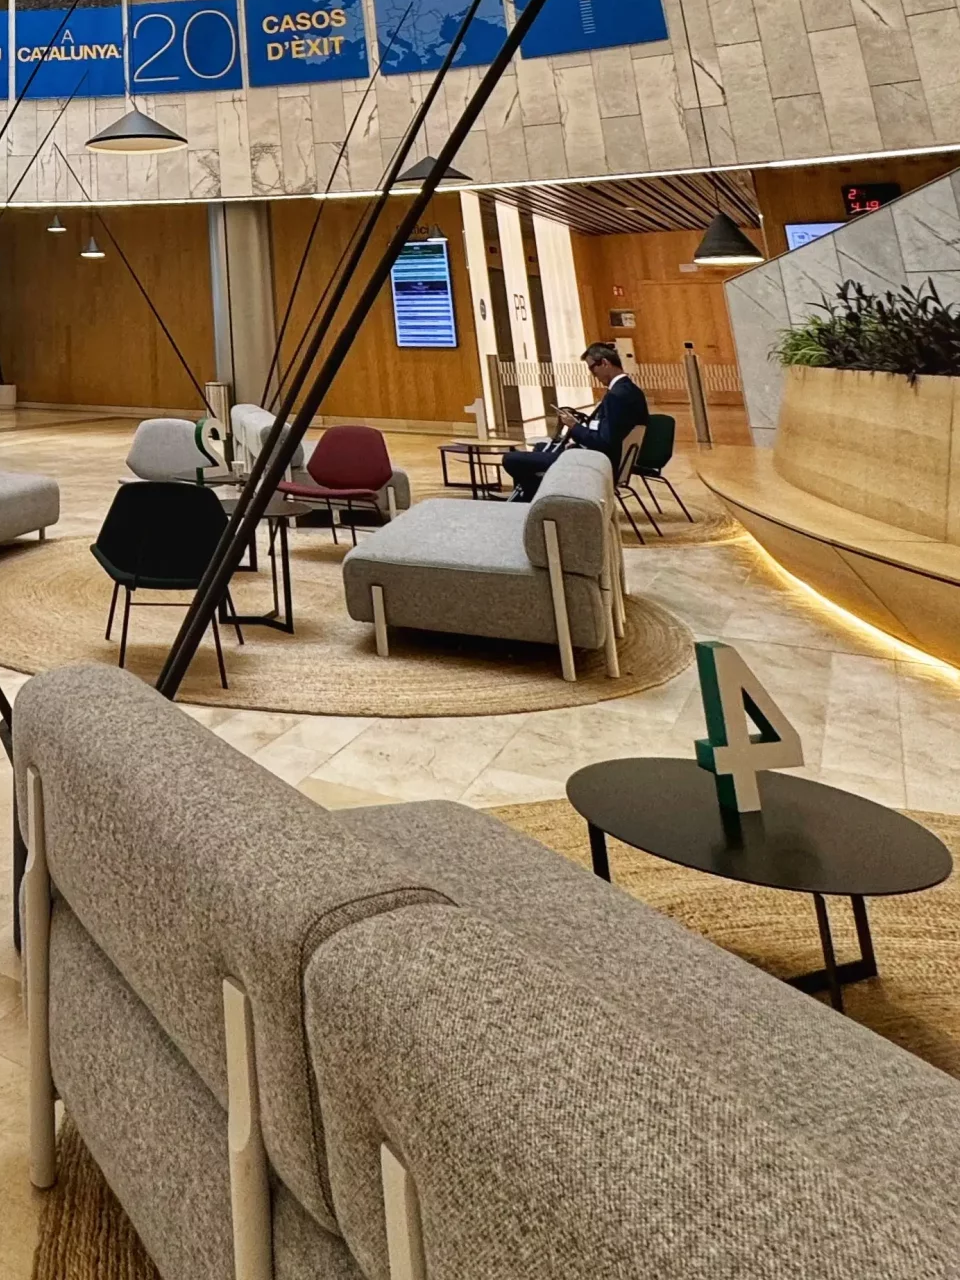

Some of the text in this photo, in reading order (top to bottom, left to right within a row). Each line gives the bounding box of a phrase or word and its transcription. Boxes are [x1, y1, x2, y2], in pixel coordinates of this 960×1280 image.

[262, 8, 346, 35] CASOS
[60, 28, 74, 45] A
[132, 9, 236, 83] 20
[266, 35, 345, 61] D'ÈXIT
[513, 293, 527, 321] PB
